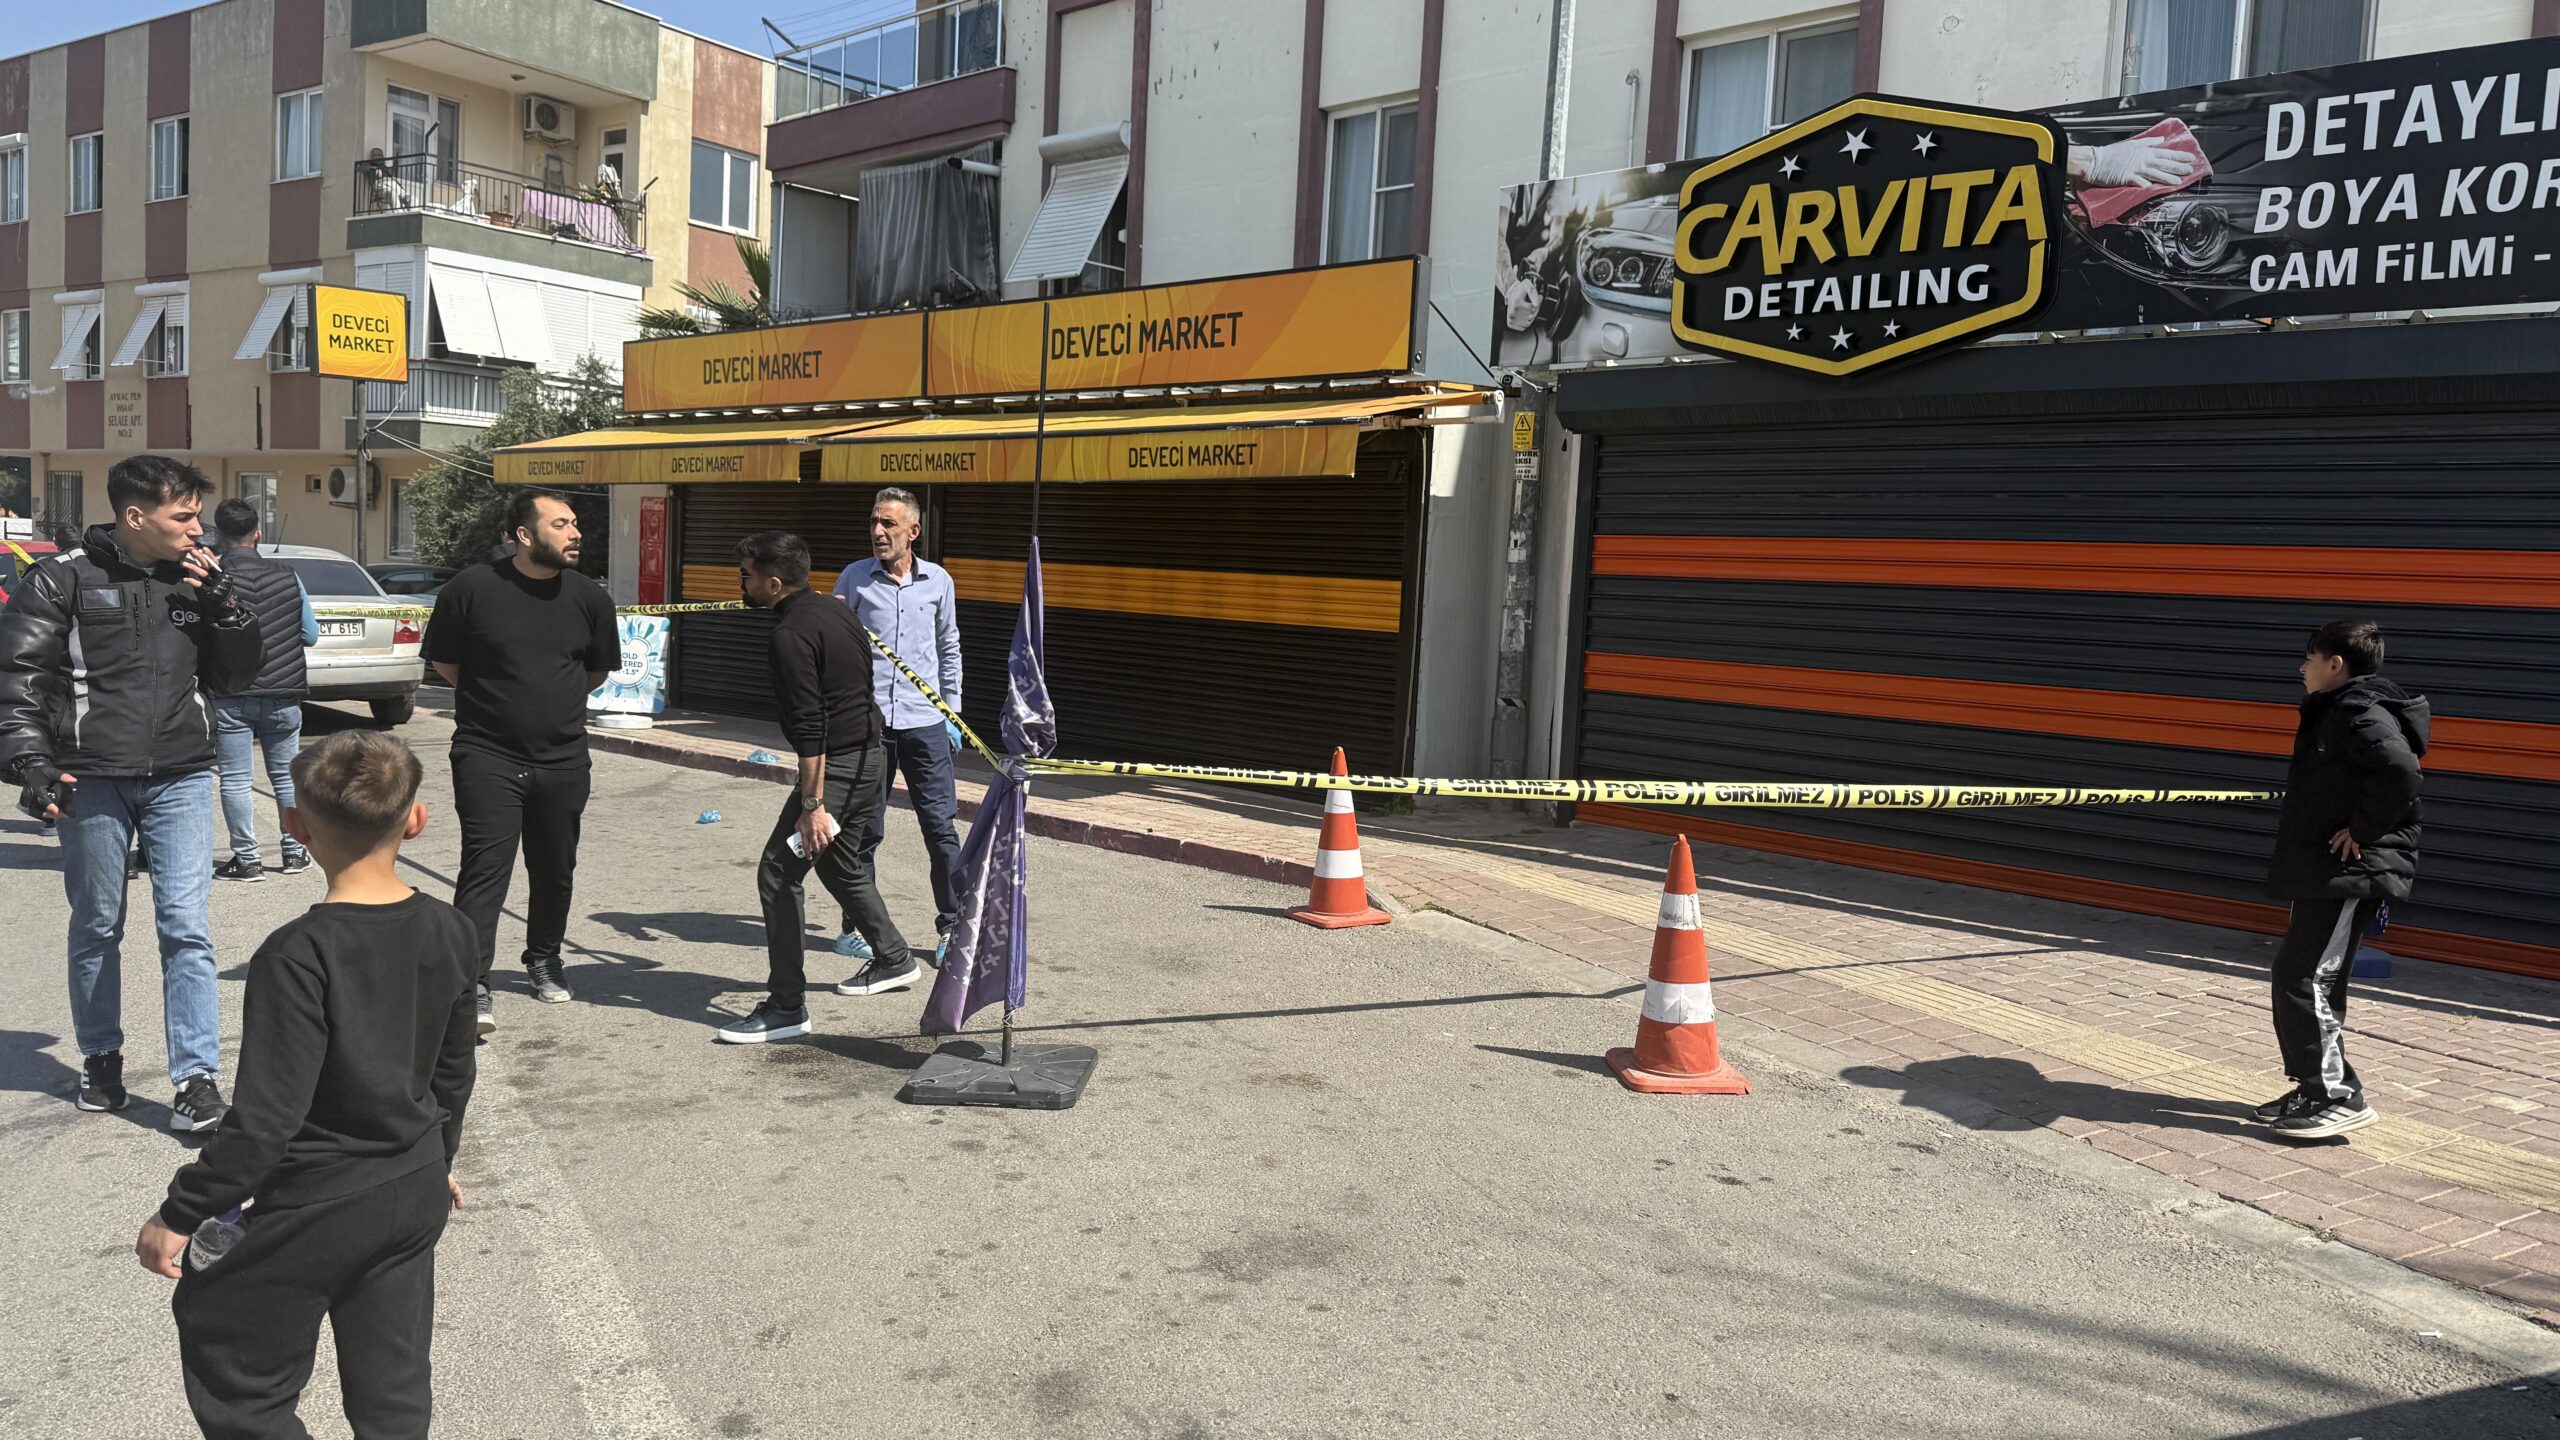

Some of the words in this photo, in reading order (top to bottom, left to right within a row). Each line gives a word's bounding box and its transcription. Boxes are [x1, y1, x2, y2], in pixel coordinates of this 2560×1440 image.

[2253, 172, 2418, 234] BOYA
[1674, 164, 2047, 276] CARVITA
[2249, 247, 2359, 292] CAM
[1723, 263, 1990, 321] DETAILING
[332, 313, 389, 334] DEVECİ
[1051, 313, 1132, 360] DEVECİ
[1138, 311, 1244, 353] MARKET
[329, 334, 394, 354] MARKET
[703, 349, 754, 385] DEVECİ
[758, 350, 823, 382] MARKET
[527, 457, 553, 476] DEVECİ
[554, 460, 585, 475] MARKET
[671, 452, 704, 474] DEVECİ
[705, 455, 745, 473] MARKET
[880, 448, 922, 472] DEVECİ
[925, 452, 976, 472] MARKET
[1128, 440, 1184, 468] DEVECİ
[1188, 443, 1258, 467] MARKET
[339, 622, 358, 634] 615
